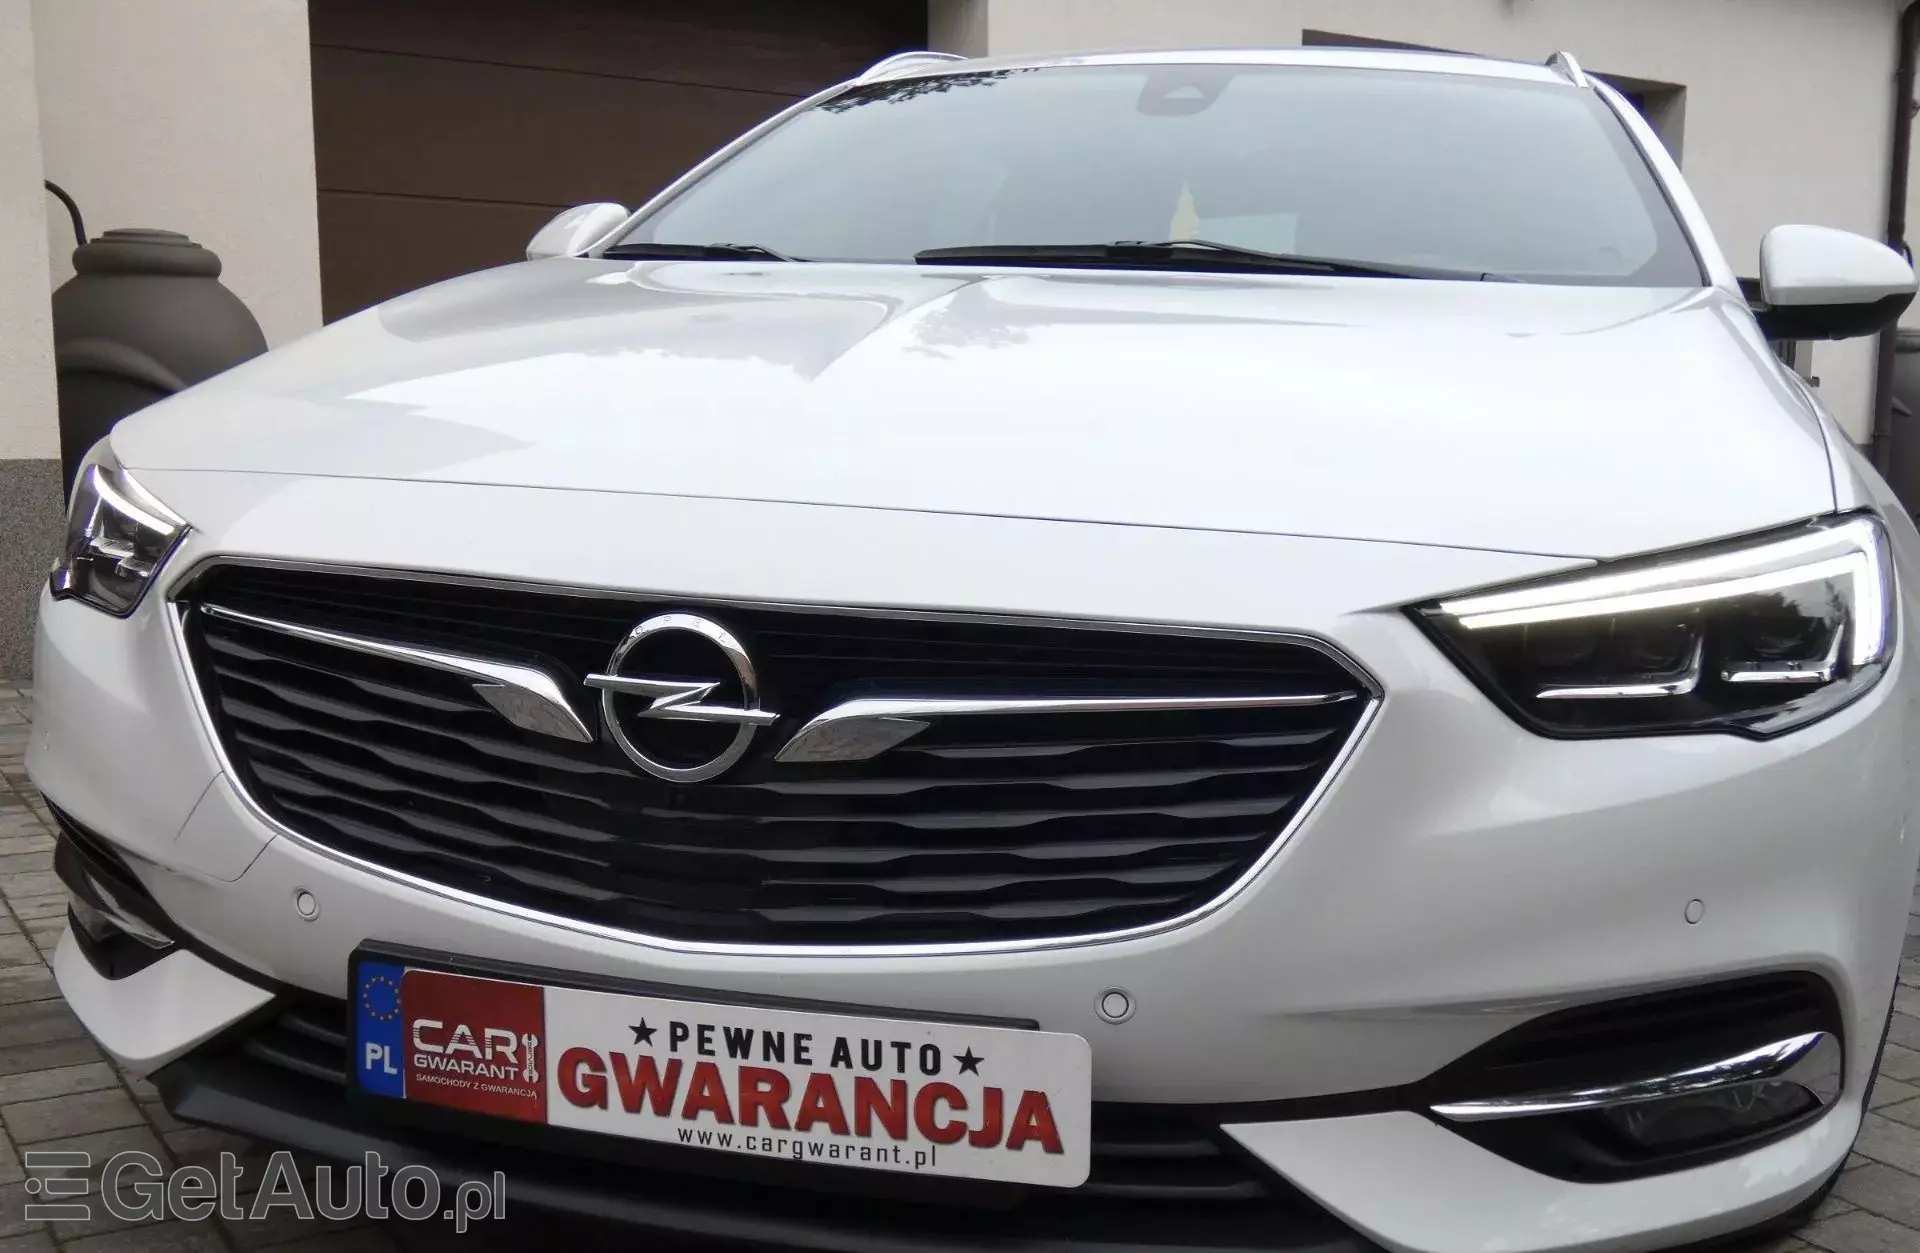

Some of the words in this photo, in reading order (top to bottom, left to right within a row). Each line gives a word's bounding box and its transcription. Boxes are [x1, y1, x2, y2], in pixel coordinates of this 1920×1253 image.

[365, 1042, 397, 1075] PL
[412, 1018, 518, 1064] CAR
[669, 1020, 813, 1065] PEWNE
[830, 1036, 941, 1076] AUTO
[413, 1053, 519, 1081] GWARANT
[416, 1073, 471, 1089] SAMOCHODY
[473, 1082, 480, 1090] Z
[557, 1047, 1065, 1155] GWARANCJA
[678, 1128, 936, 1169] www.cargwarant.pl
